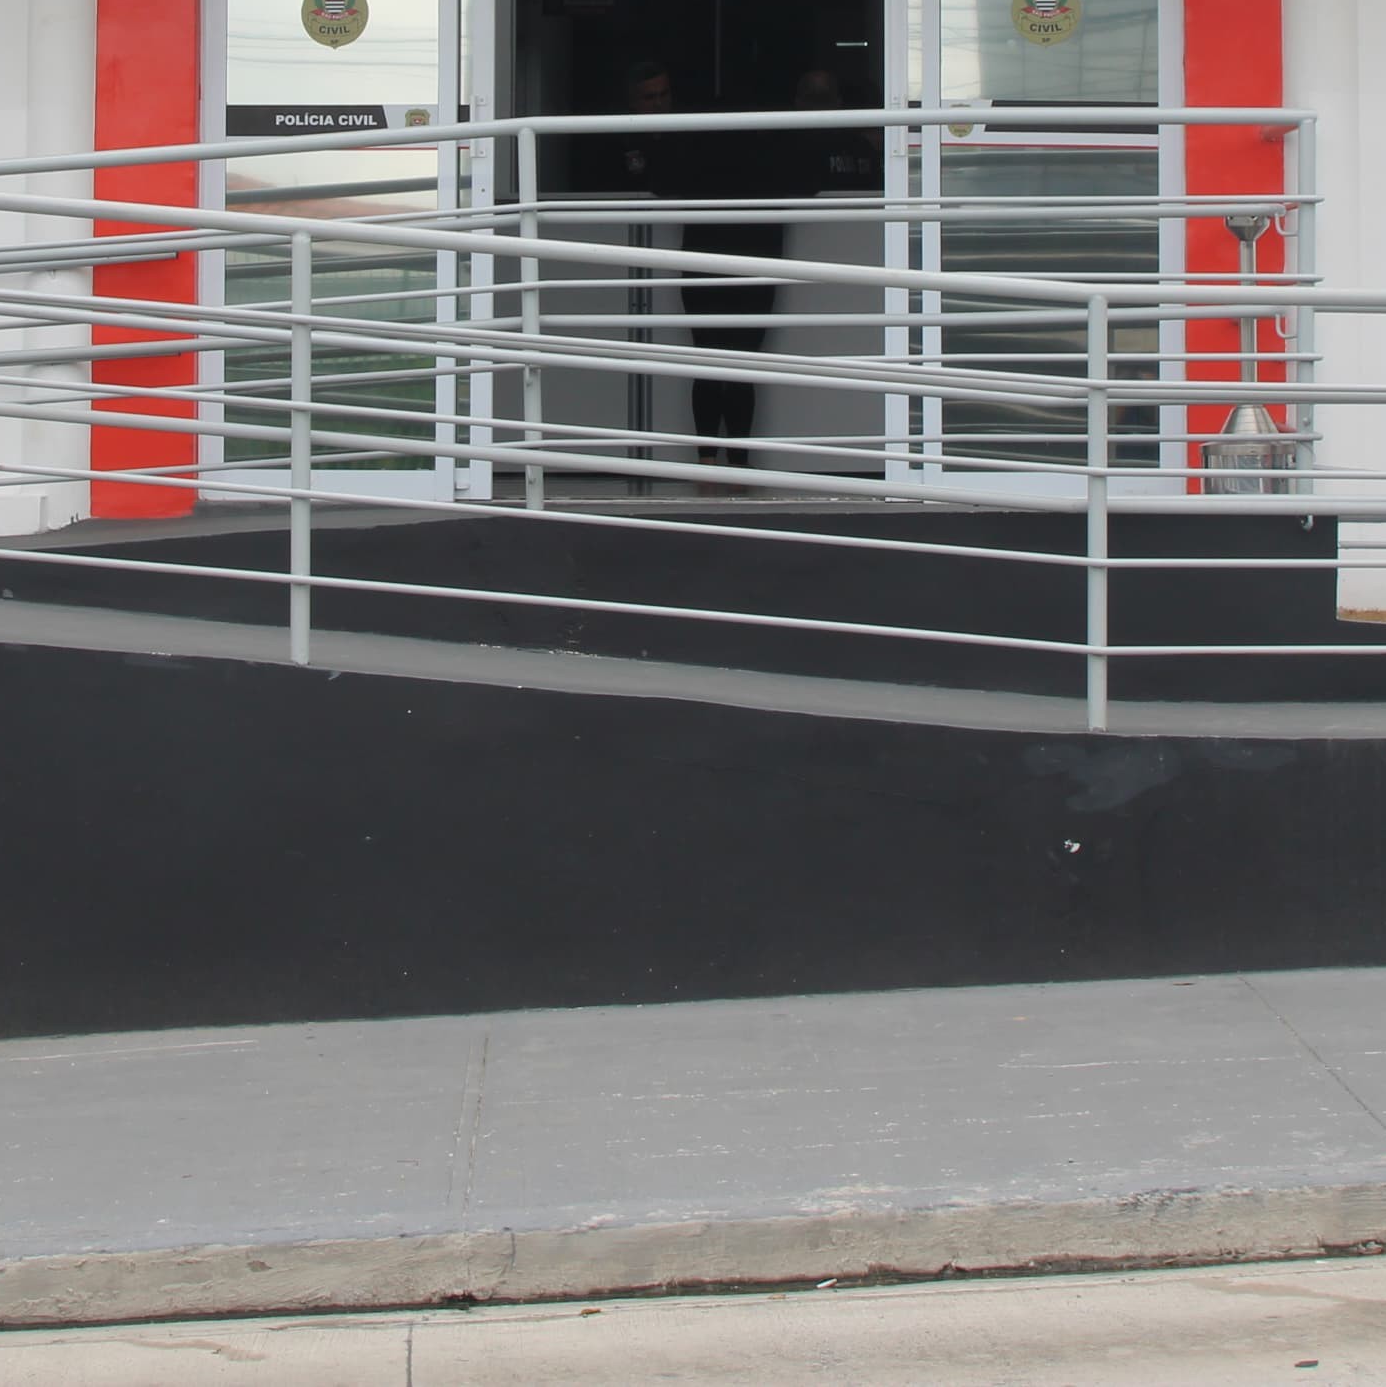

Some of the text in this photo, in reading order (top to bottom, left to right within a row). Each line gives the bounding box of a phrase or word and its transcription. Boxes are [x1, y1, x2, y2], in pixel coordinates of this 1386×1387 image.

[318, 25, 350, 35] CIVIL
[1029, 23, 1062, 33] CIVIL
[275, 112, 378, 126] POLÍCIA CIVIL
